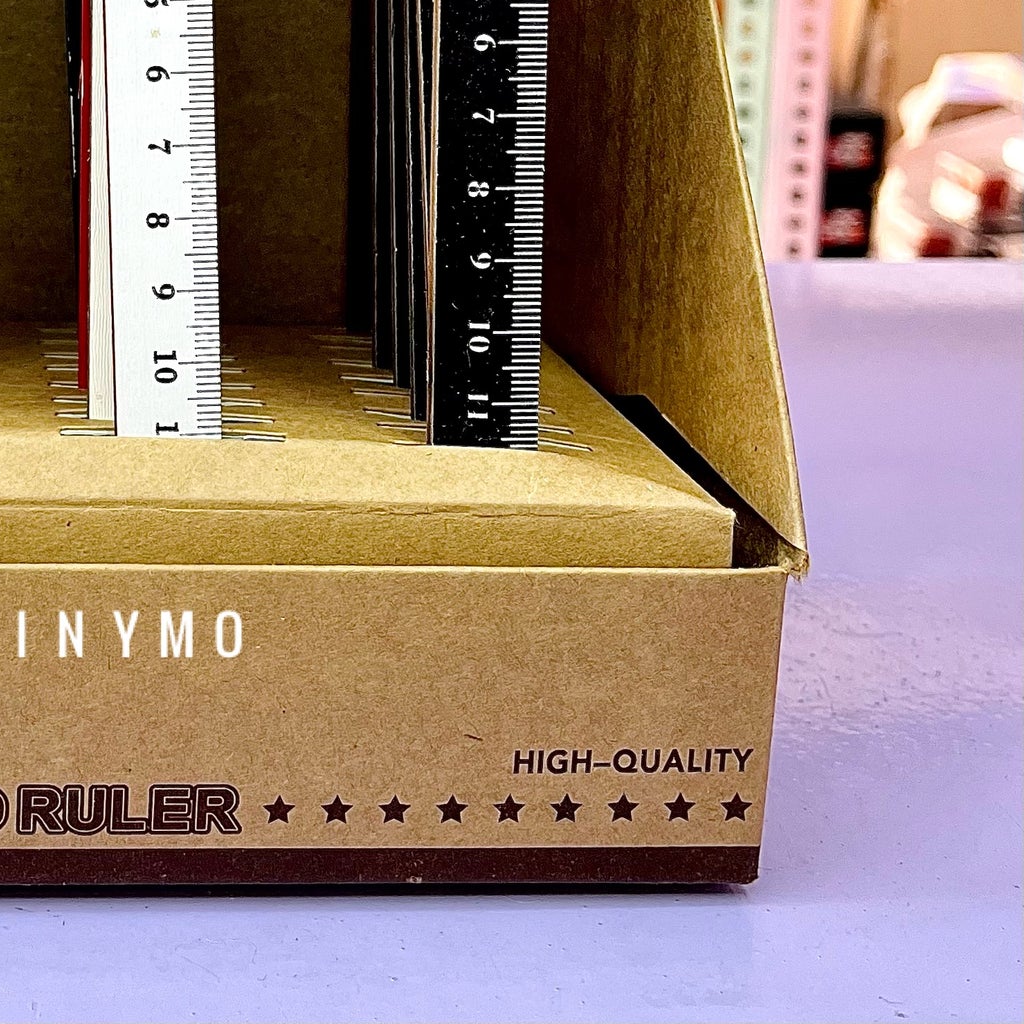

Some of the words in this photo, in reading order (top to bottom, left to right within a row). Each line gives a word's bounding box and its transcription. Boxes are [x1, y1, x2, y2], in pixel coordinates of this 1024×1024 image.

[473, 33, 497, 52] 6
[145, 64, 171, 83] 6
[472, 107, 495, 124] 7
[147, 138, 172, 155] 7
[467, 180, 490, 198] 8
[145, 212, 170, 229] 8
[469, 252, 492, 270] 9
[151, 283, 176, 301] 9
[468, 321, 491, 353] 10
[153, 349, 178, 384] 10
[467, 393, 489, 419] 11
[17, 783, 243, 835] RULER
